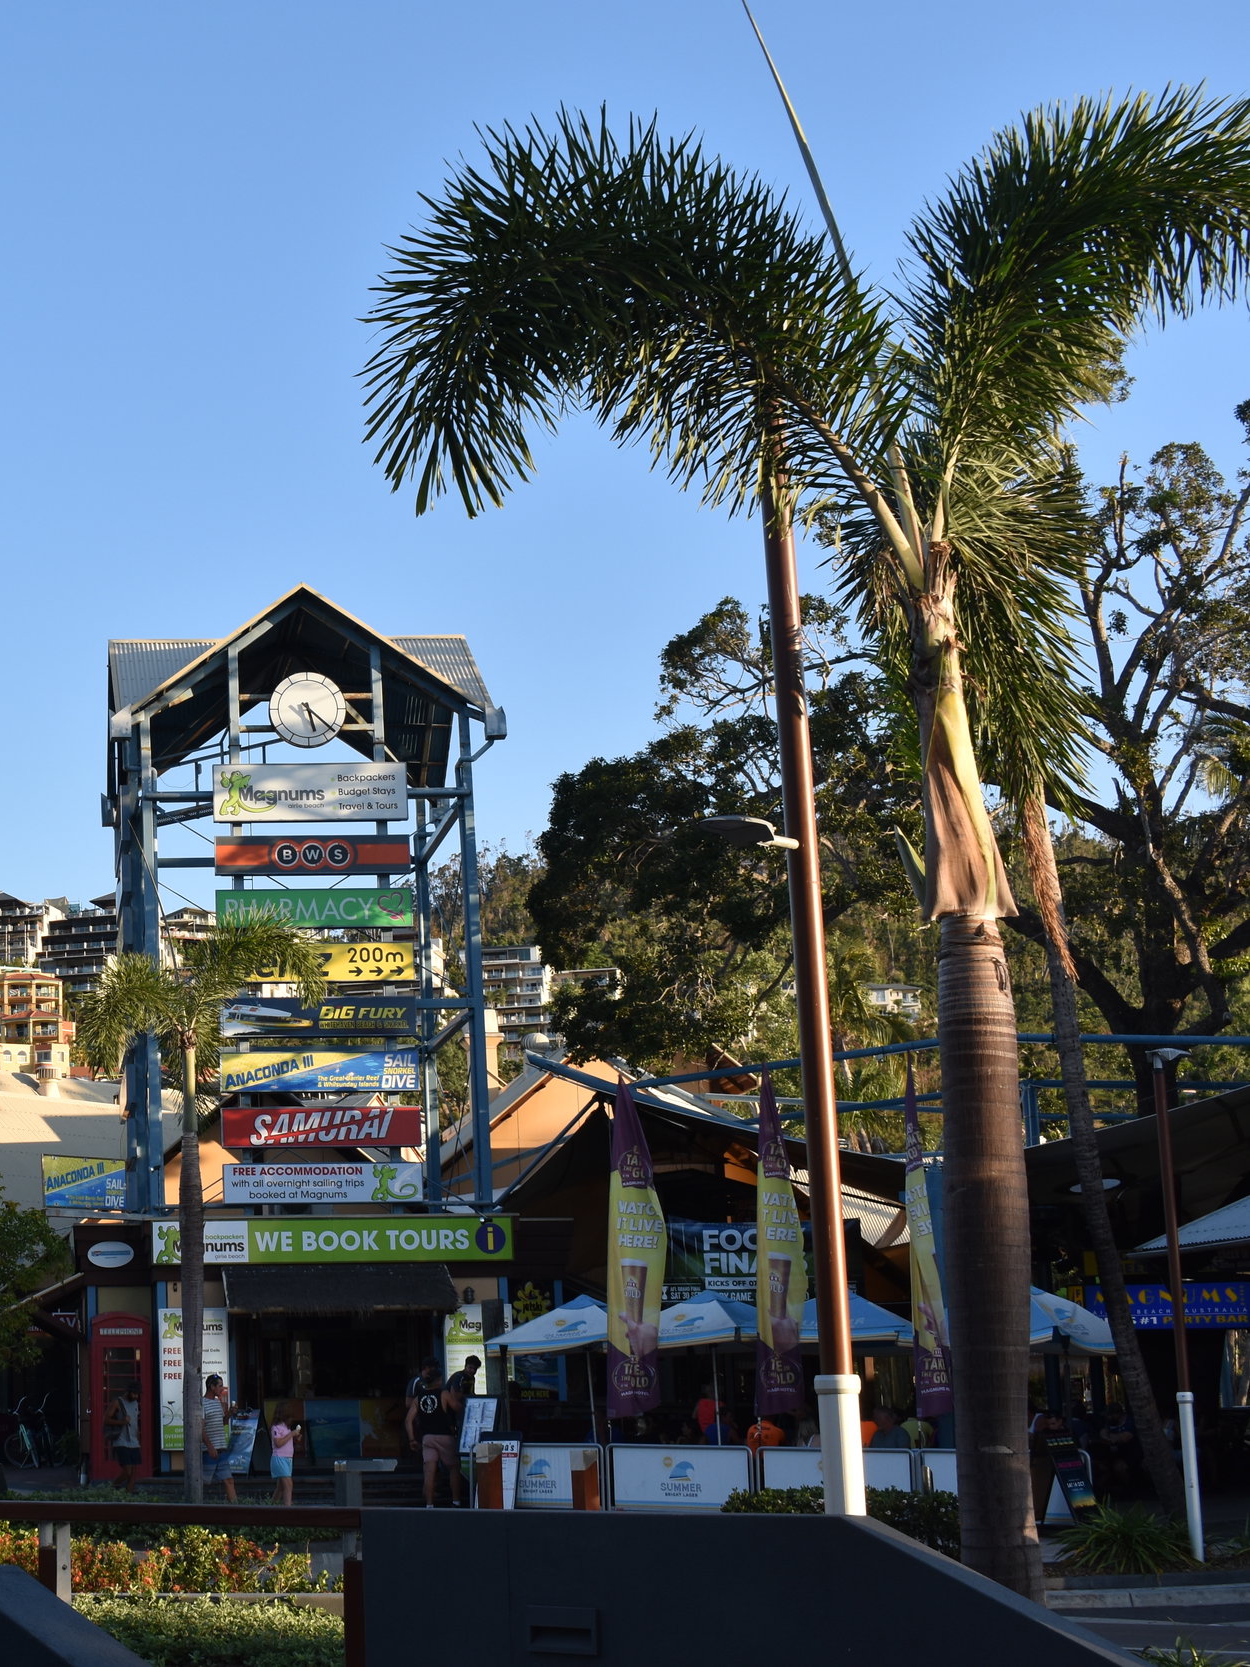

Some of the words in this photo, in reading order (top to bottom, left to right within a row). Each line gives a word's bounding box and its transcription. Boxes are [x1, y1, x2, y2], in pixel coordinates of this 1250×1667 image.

[337, 774, 396, 783] Backpackers
[239, 785, 325, 805] Magnums
[338, 787, 370, 797] Budget
[372, 786, 396, 796] Stays
[338, 802, 364, 811] Travel
[367, 802, 373, 810] &
[375, 801, 398, 810] Tours
[224, 897, 374, 921] PHARMACY
[347, 947, 404, 963] 200m
[358, 1007, 407, 1018] FURY
[319, 1020, 355, 1029] WHITEHAVEN
[356, 1020, 375, 1028] BEACH
[384, 1020, 409, 1028] SNORKEL
[384, 1054, 415, 1067] SAIL
[225, 1060, 299, 1090] ANACONDA
[302, 1054, 314, 1069] III
[381, 1075, 416, 1088] DIVE
[250, 1108, 393, 1145] SAMURAI
[232, 1167, 256, 1176] FREE
[260, 1167, 363, 1176] ACCOMMODATION
[46, 1165, 95, 1191] ANACONDA
[106, 1178, 125, 1190] SAIL
[253, 1179, 264, 1187] all
[266, 1179, 310, 1189] overnight
[312, 1179, 344, 1189] sailing
[345, 1179, 365, 1189] trips
[249, 1190, 286, 1199] booked
[288, 1190, 298, 1199] at
[301, 1190, 348, 1200] Magnums
[105, 1195, 125, 1207] DIVE
[629, 1219, 664, 1234] LIVE
[254, 1230, 292, 1252] WE
[302, 1229, 381, 1252] BOOK
[385, 1228, 470, 1251] TOURS
[618, 1233, 659, 1249] HERE!
[670, 1291, 682, 1299] SAT
[682, 1291, 690, 1299] 30
[1140, 1316, 1158, 1325] #1
[1162, 1316, 1217, 1324] PRTY
[1218, 1315, 1249, 1323] BAR
[102, 1328, 141, 1336] TELEPHONE
[518, 1480, 558, 1489] SUMMER
[660, 1482, 703, 1493] SUMMER
